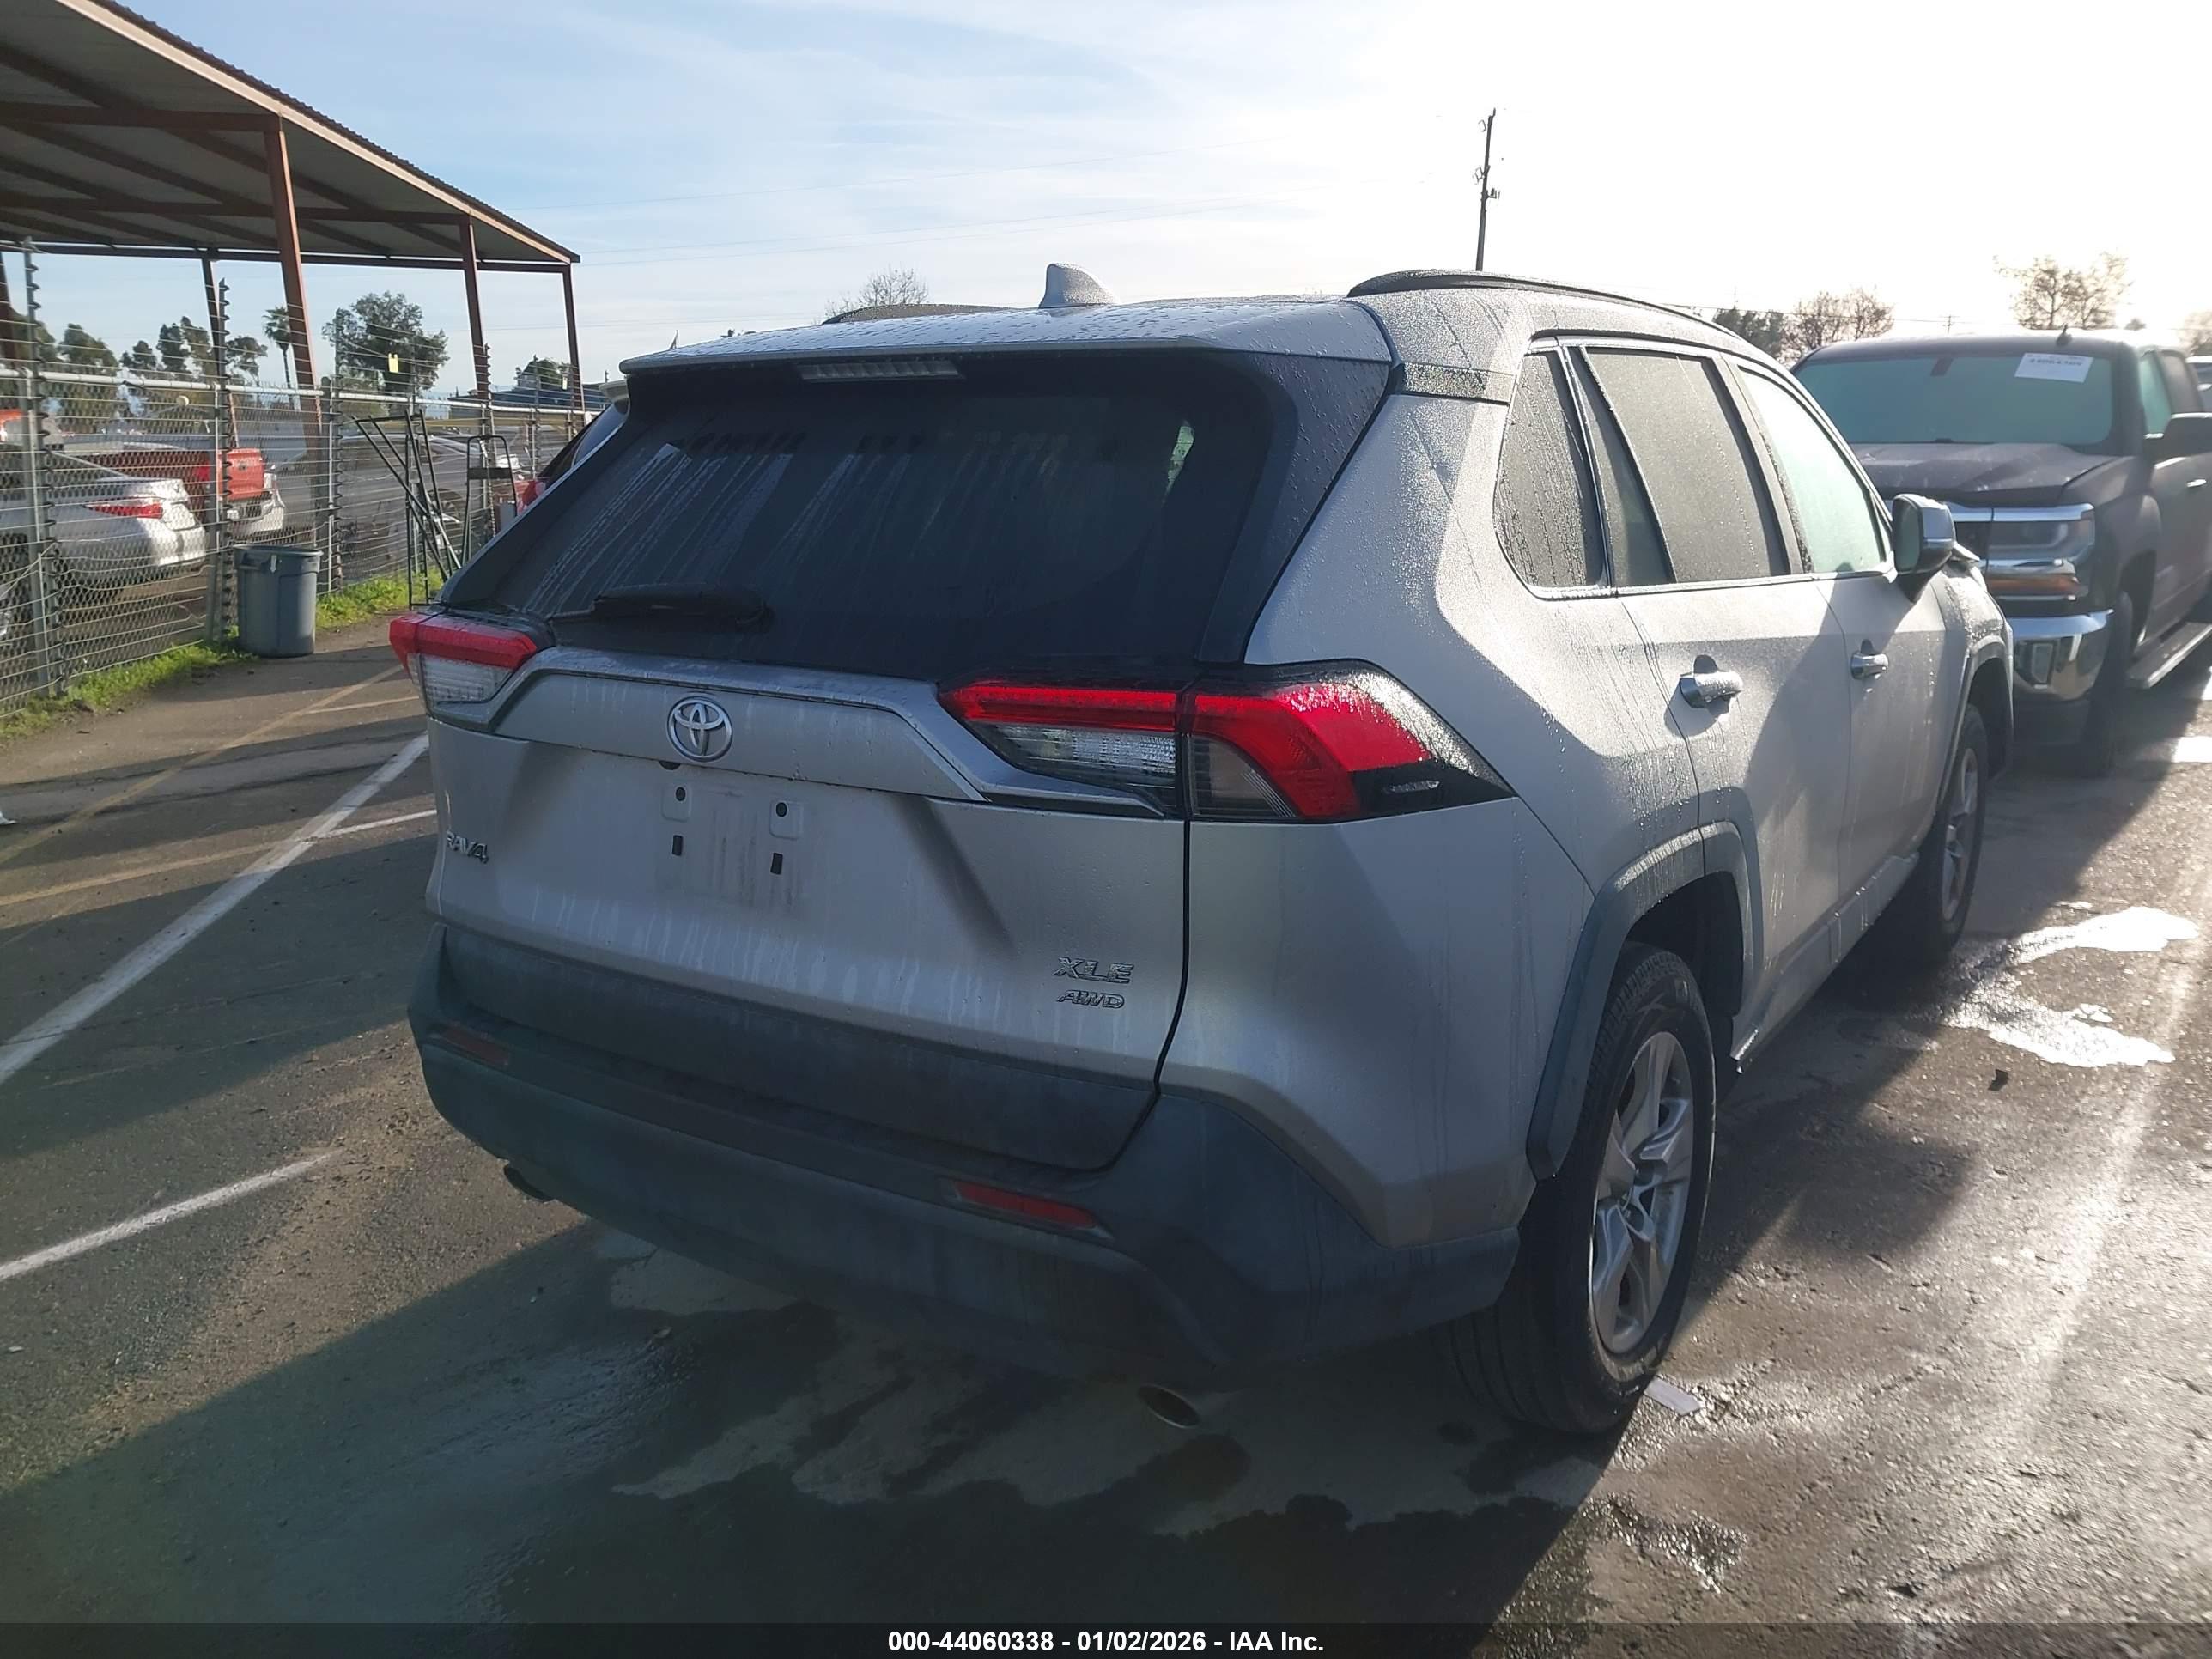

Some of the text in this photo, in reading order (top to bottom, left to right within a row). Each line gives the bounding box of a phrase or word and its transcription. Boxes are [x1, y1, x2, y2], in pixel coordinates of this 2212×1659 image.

[446, 830, 489, 864] RAV4
[1053, 957, 1133, 984] XLE
[1056, 989, 1125, 1008] AWD
